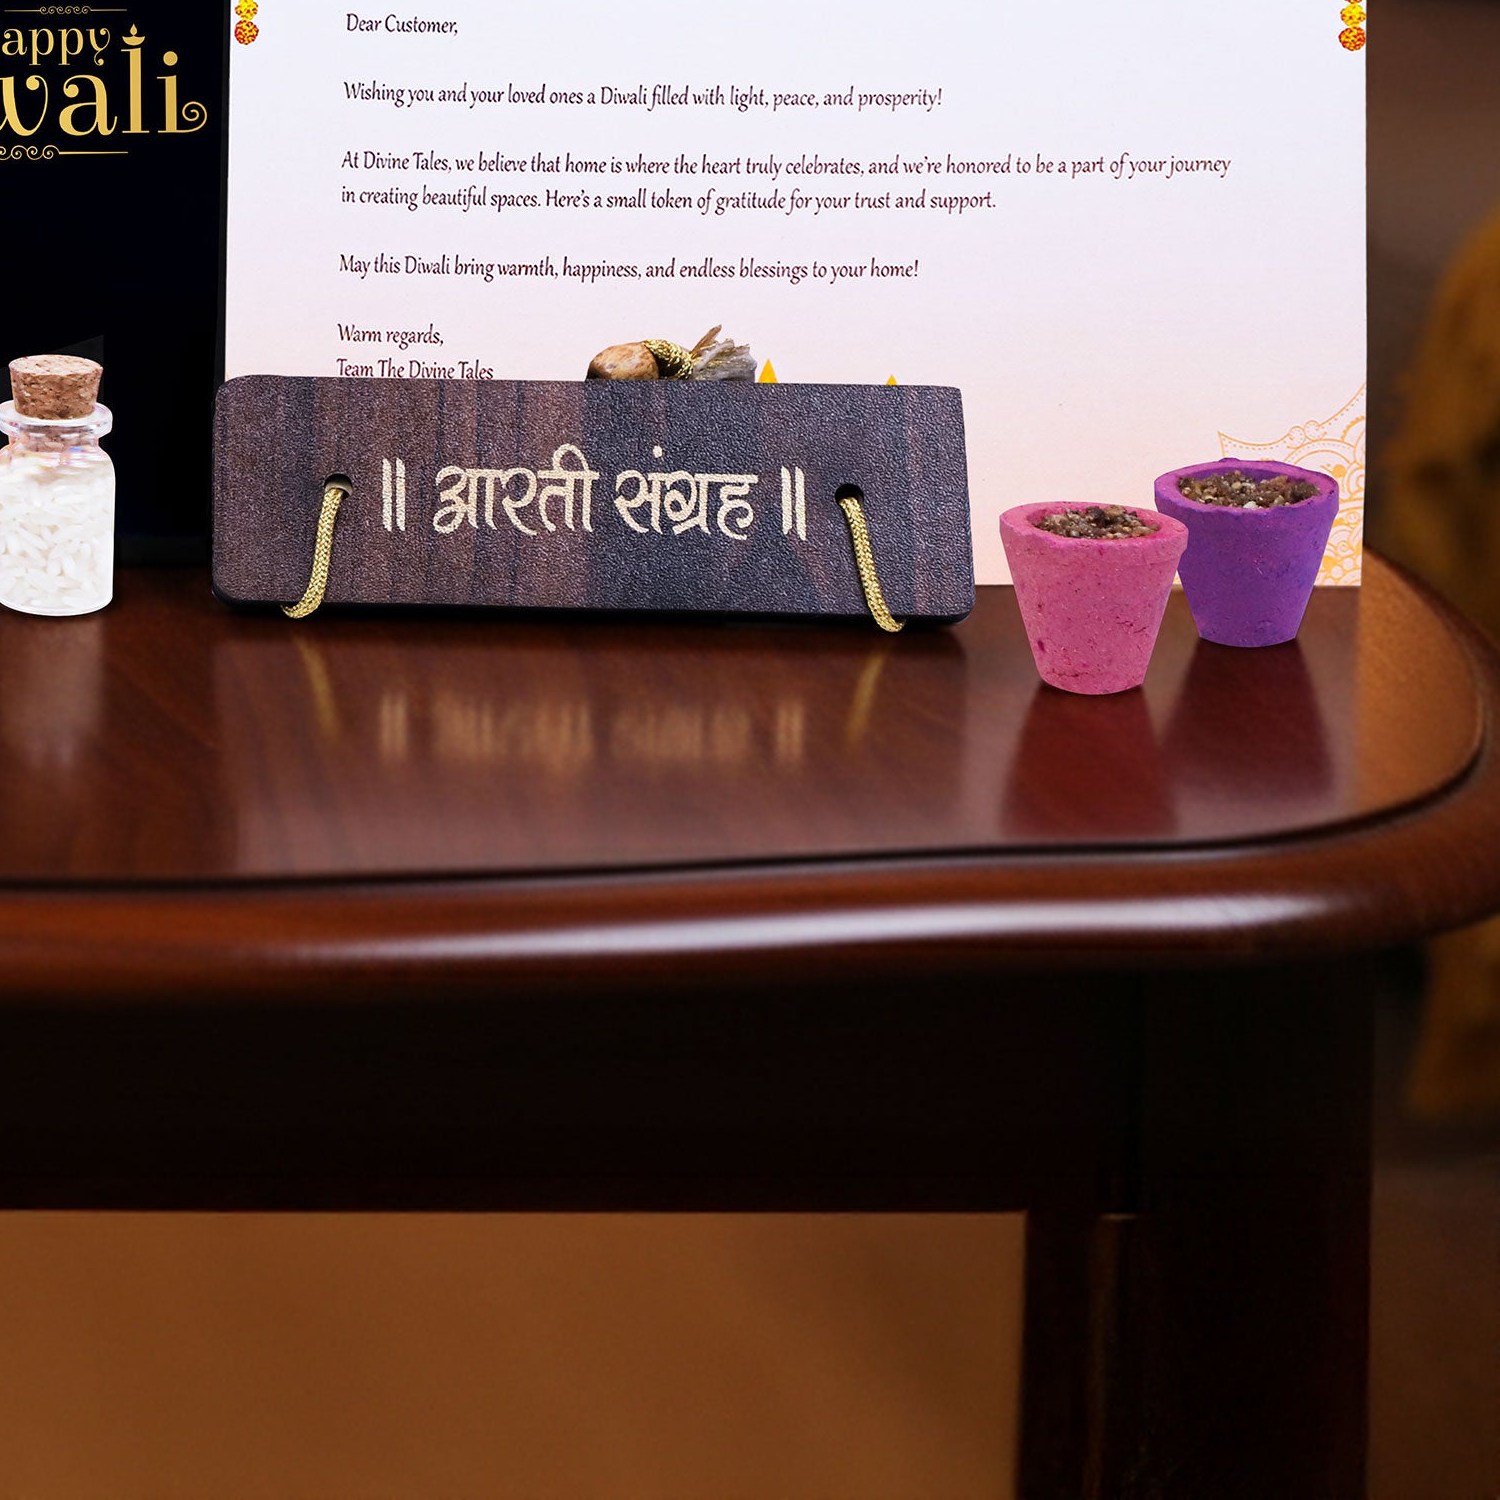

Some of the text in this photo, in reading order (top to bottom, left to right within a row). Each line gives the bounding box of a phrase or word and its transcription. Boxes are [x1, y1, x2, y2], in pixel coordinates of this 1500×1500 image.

[347, 13, 458, 36] Dear Customer,
[344, 80, 942, 112] Wishing you and your loved ones a Diwali filled with light, peace, and prosperity!
[341, 150, 1231, 181] At Divine Tales, we believe that home is where the heart truly celebrates, and we’re honored to be a part of your journey
[342, 185, 996, 215] in creating beautiful spaces. Here’s a small token of gratitude for your trust and support.
[340, 253, 918, 285] May this Diwali bring warmth, happiness, and endless blessings to your home!
[337, 323, 445, 350] Warm regards,
[336, 357, 494, 380] Team The Divine Tales
[432, 443, 597, 536] आरती
[613, 445, 758, 541] संग्रह
